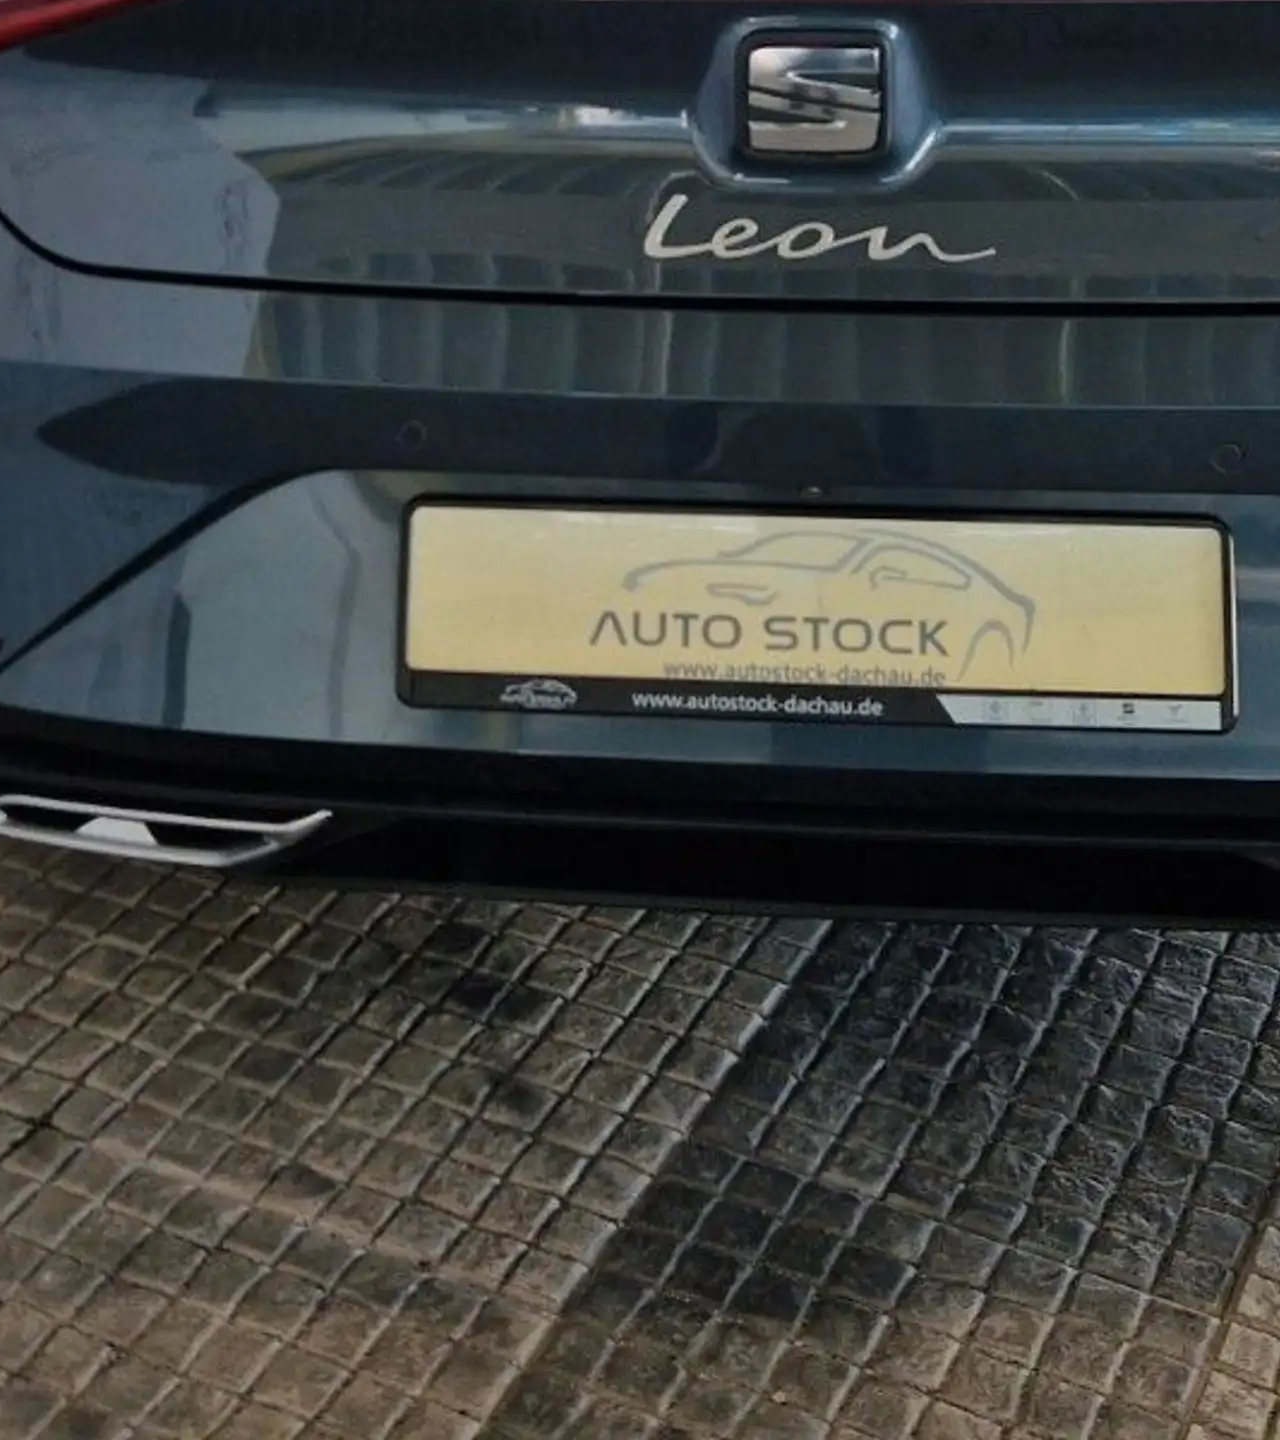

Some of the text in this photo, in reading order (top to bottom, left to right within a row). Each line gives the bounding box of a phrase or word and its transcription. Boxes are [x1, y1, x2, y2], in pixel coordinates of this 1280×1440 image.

[643, 193, 997, 262] Leon
[589, 610, 950, 657] AUTO STOCK
[663, 659, 947, 688] www.autostock-dachau.de
[631, 691, 884, 717] www.autostock-dachau.de
